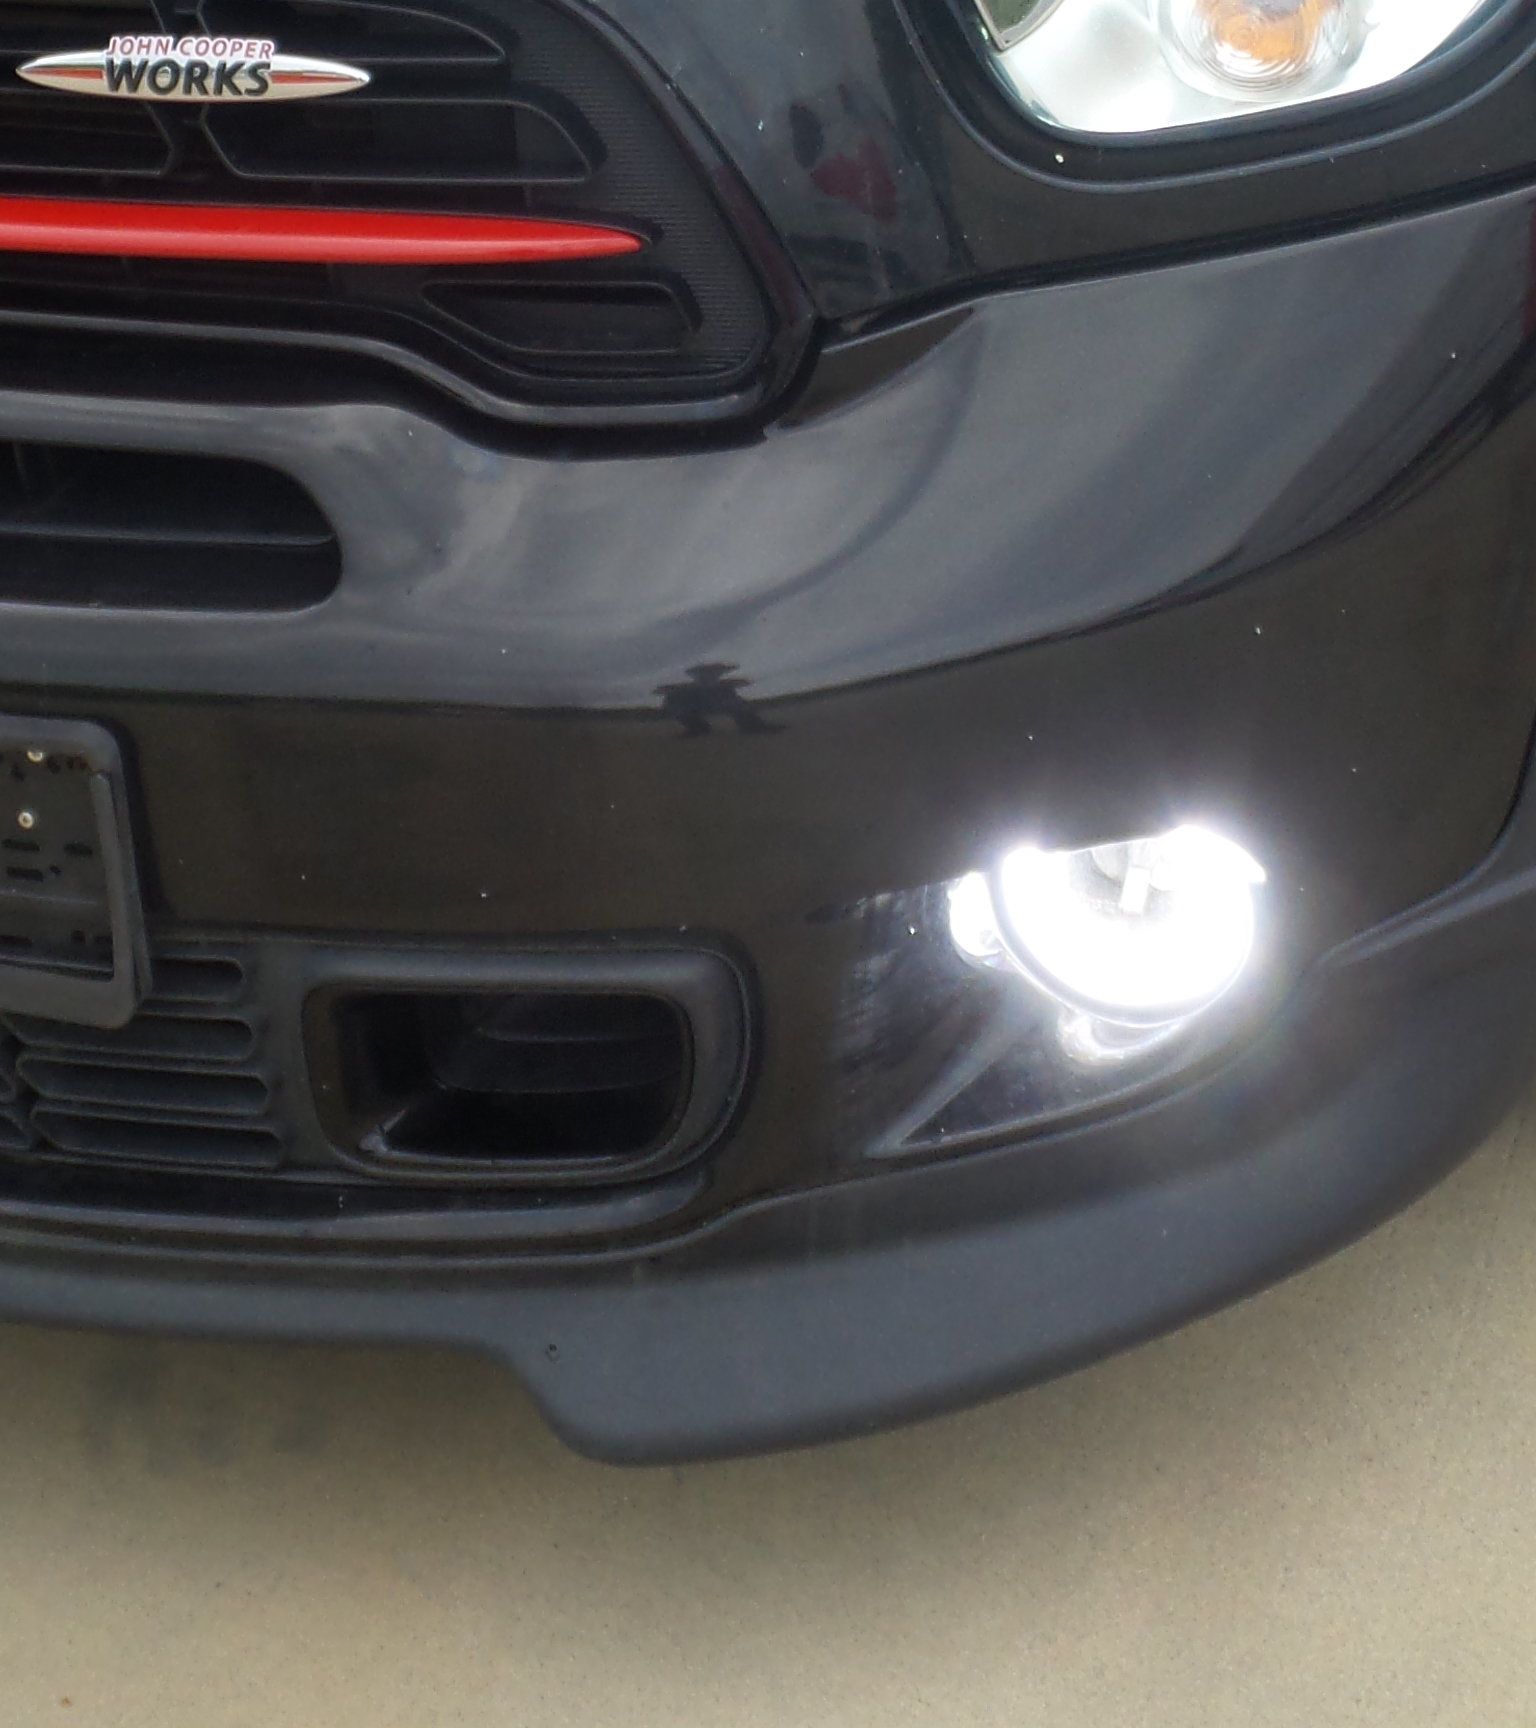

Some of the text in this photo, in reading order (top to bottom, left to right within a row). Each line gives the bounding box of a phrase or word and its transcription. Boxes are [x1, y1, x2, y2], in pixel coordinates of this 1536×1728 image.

[105, 36, 273, 59] JOHN COOPER
[105, 57, 272, 96] WORKS
